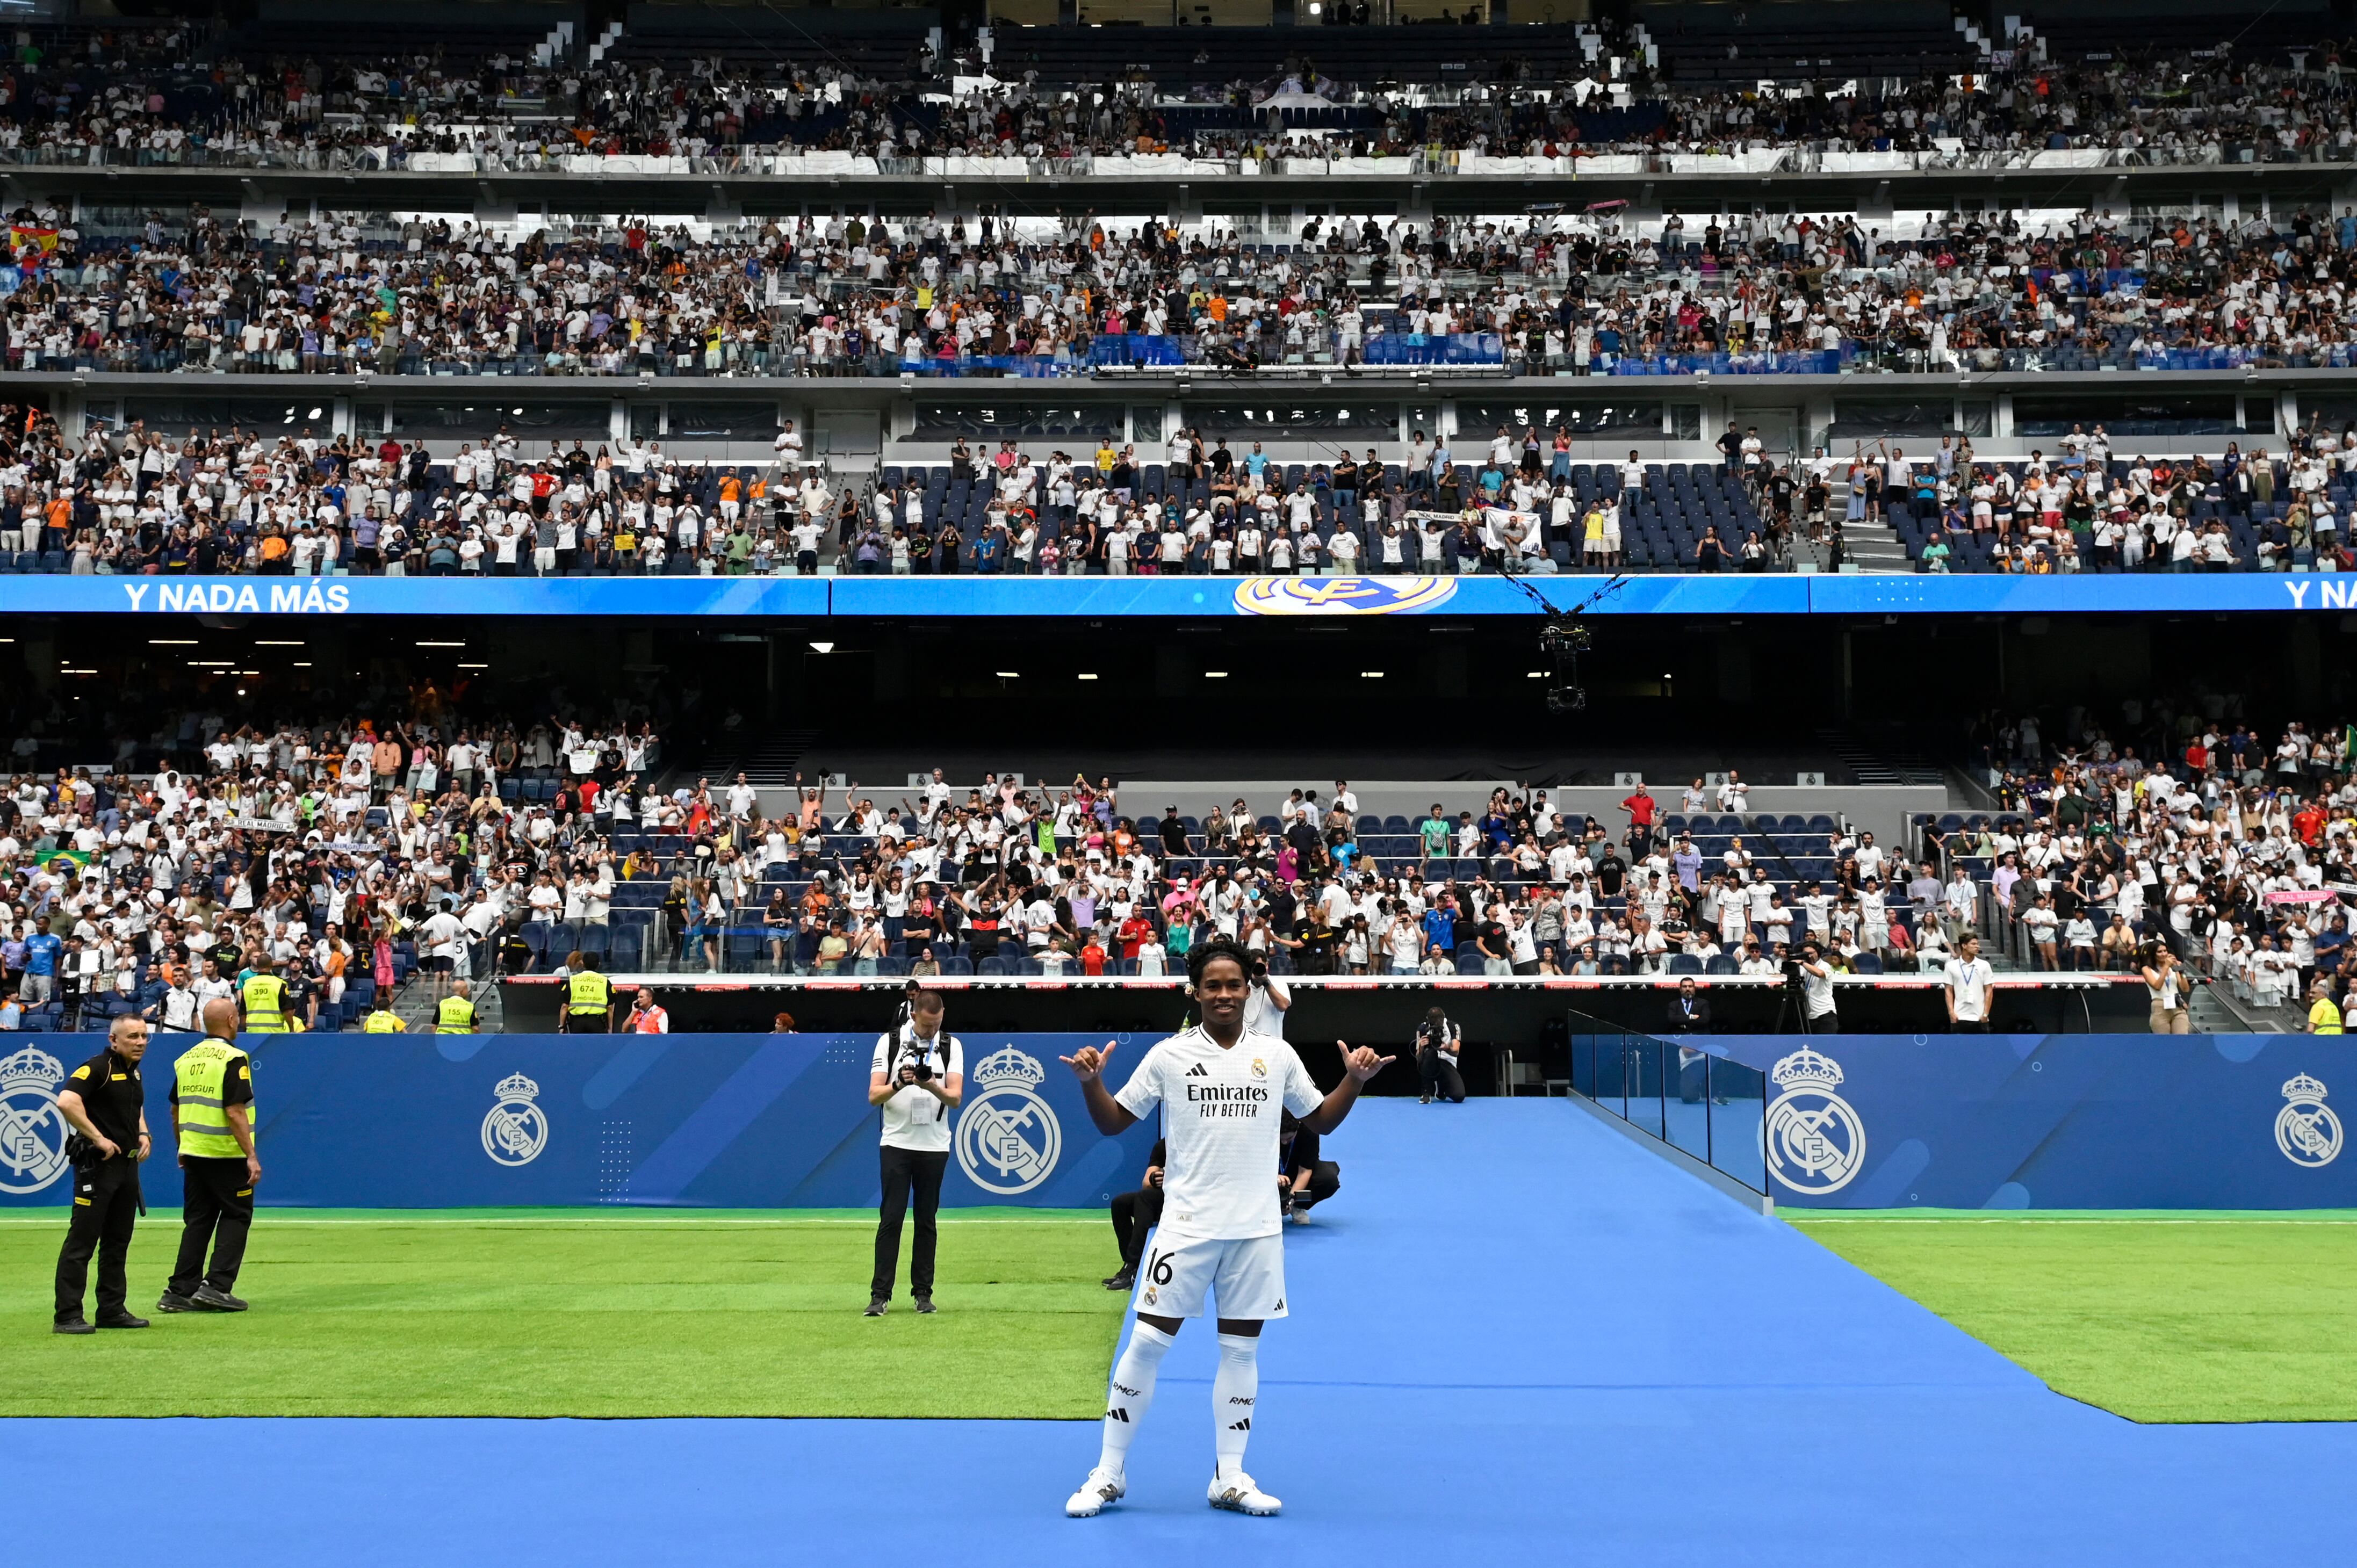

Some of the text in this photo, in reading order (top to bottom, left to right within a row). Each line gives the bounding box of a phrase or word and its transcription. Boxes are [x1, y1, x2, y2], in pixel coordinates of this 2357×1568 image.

[124, 578, 349, 613] Y NADA MÁS
[2284, 581, 2310, 608] Y
[257, 821, 285, 830] MADRID
[456, 941, 463, 955] 5
[1518, 937, 1524, 945] 10
[361, 952, 370, 970] 5
[572, 976, 604, 984] SEGURIDAD
[1187, 1083, 1268, 1102] Emirates
[1200, 1104, 1258, 1118] FLY BETTER
[1145, 1247, 1175, 1285] 16
[1113, 1381, 1141, 1397] RMCF
